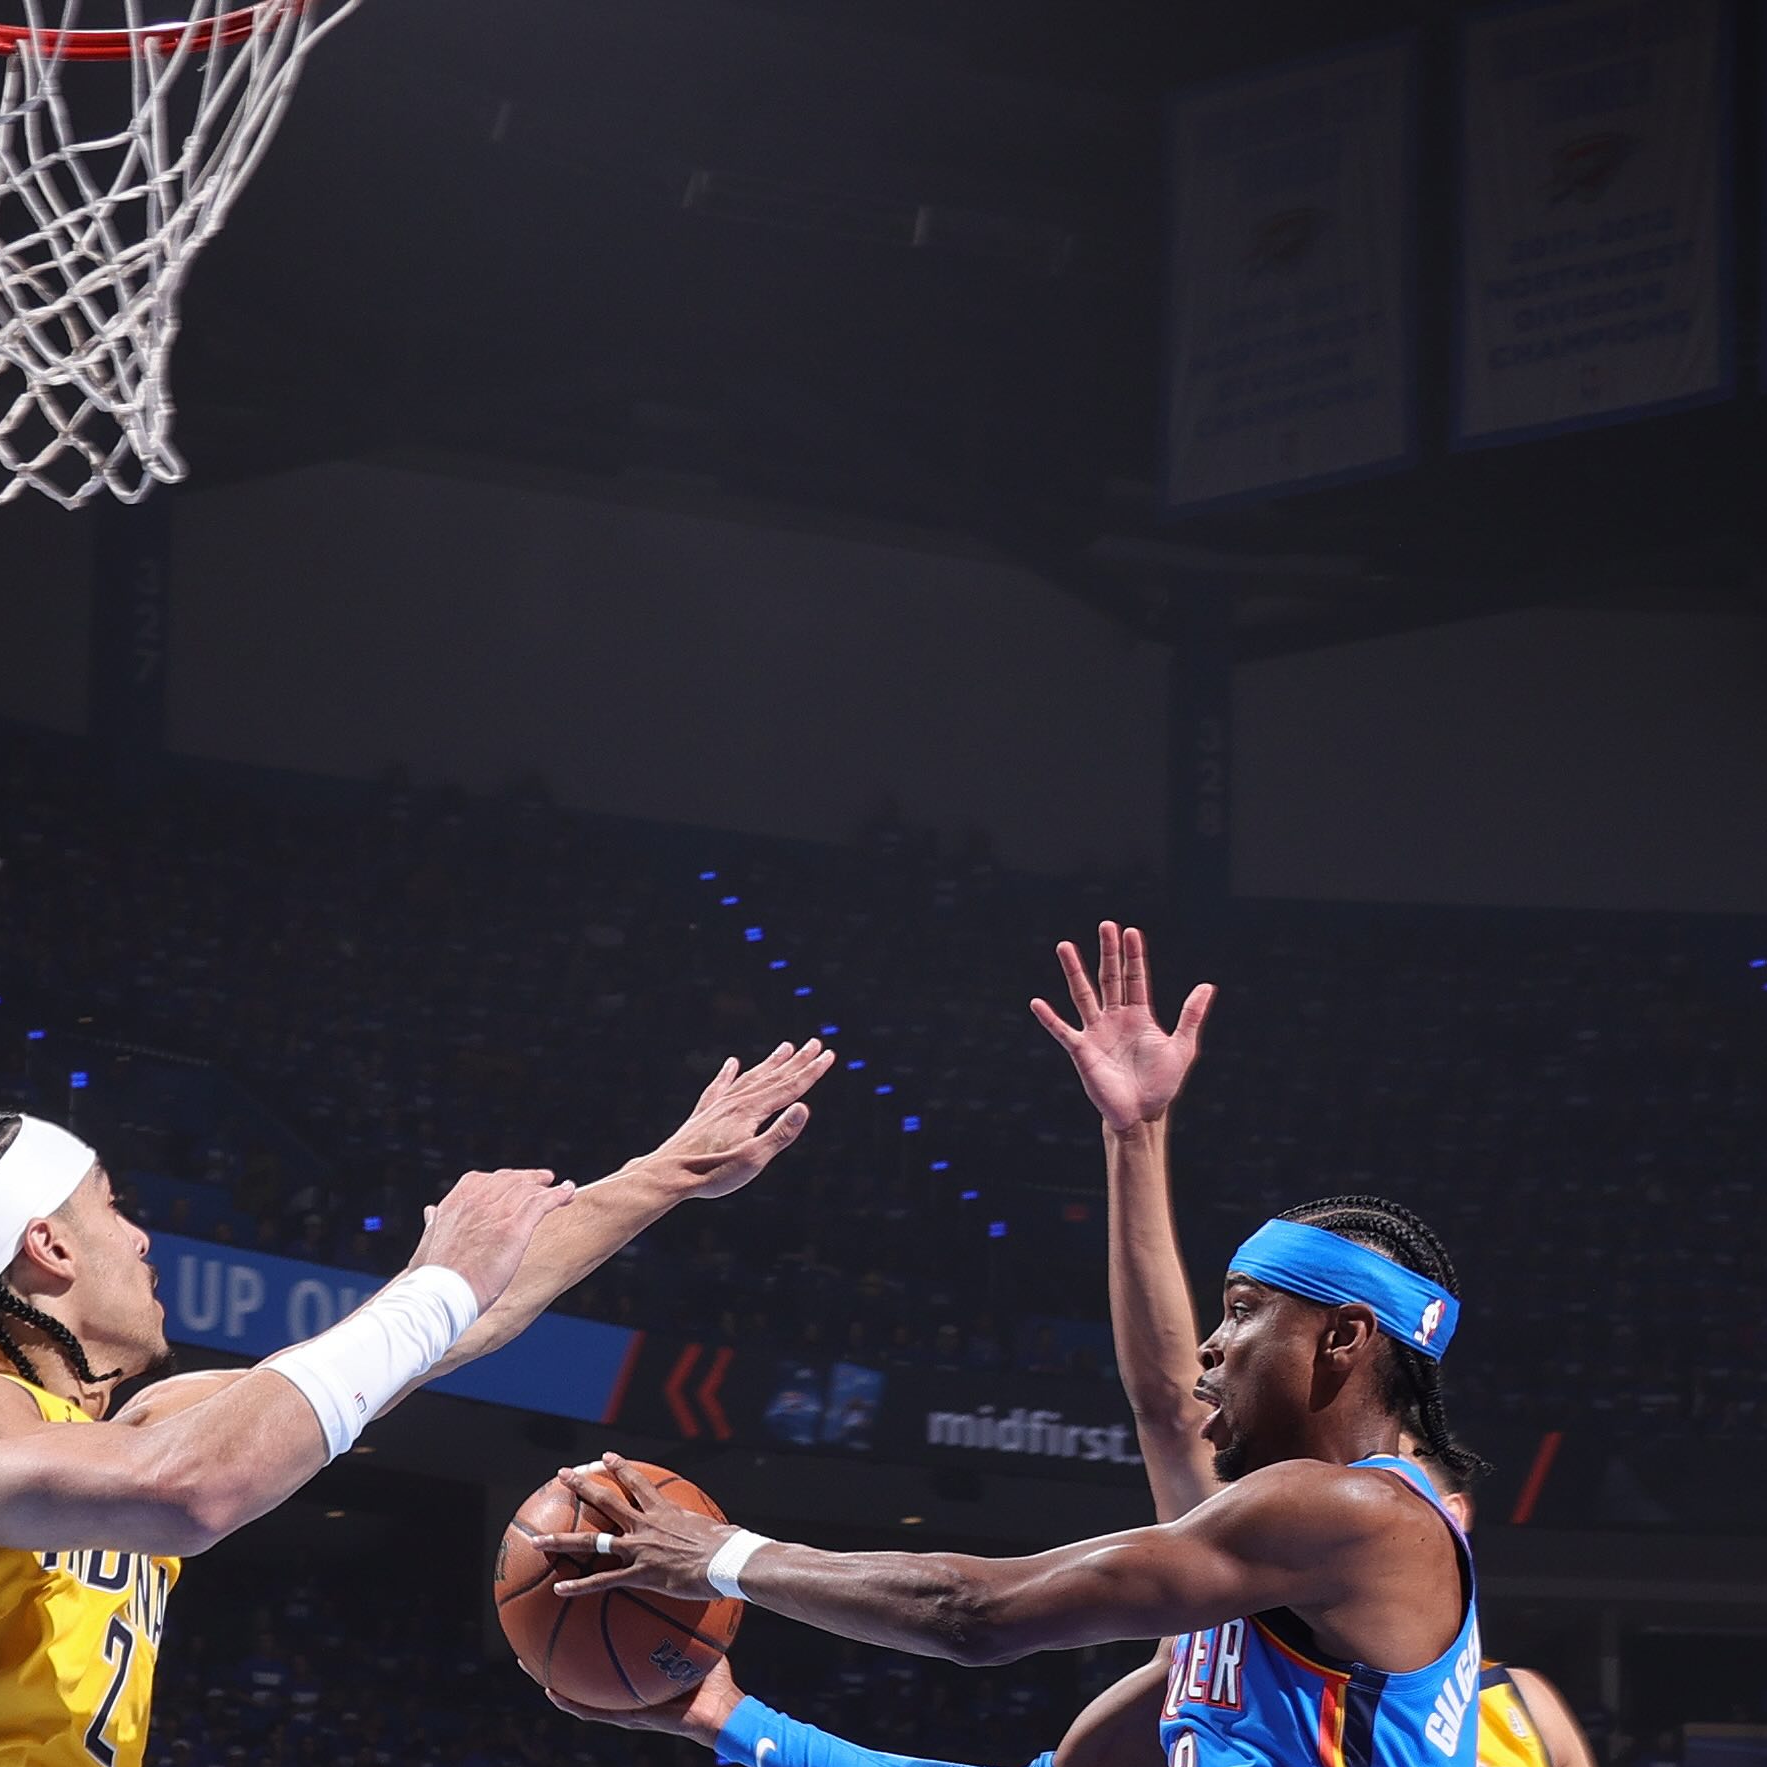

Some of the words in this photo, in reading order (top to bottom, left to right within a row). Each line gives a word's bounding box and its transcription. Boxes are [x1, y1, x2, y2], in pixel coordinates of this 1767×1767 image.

[1513, 281, 1664, 332] DIVISION
[1489, 310, 1692, 370] CHAMPIONS
[178, 1255, 266, 1338] UP
[926, 1404, 1146, 1465] midfirst.
